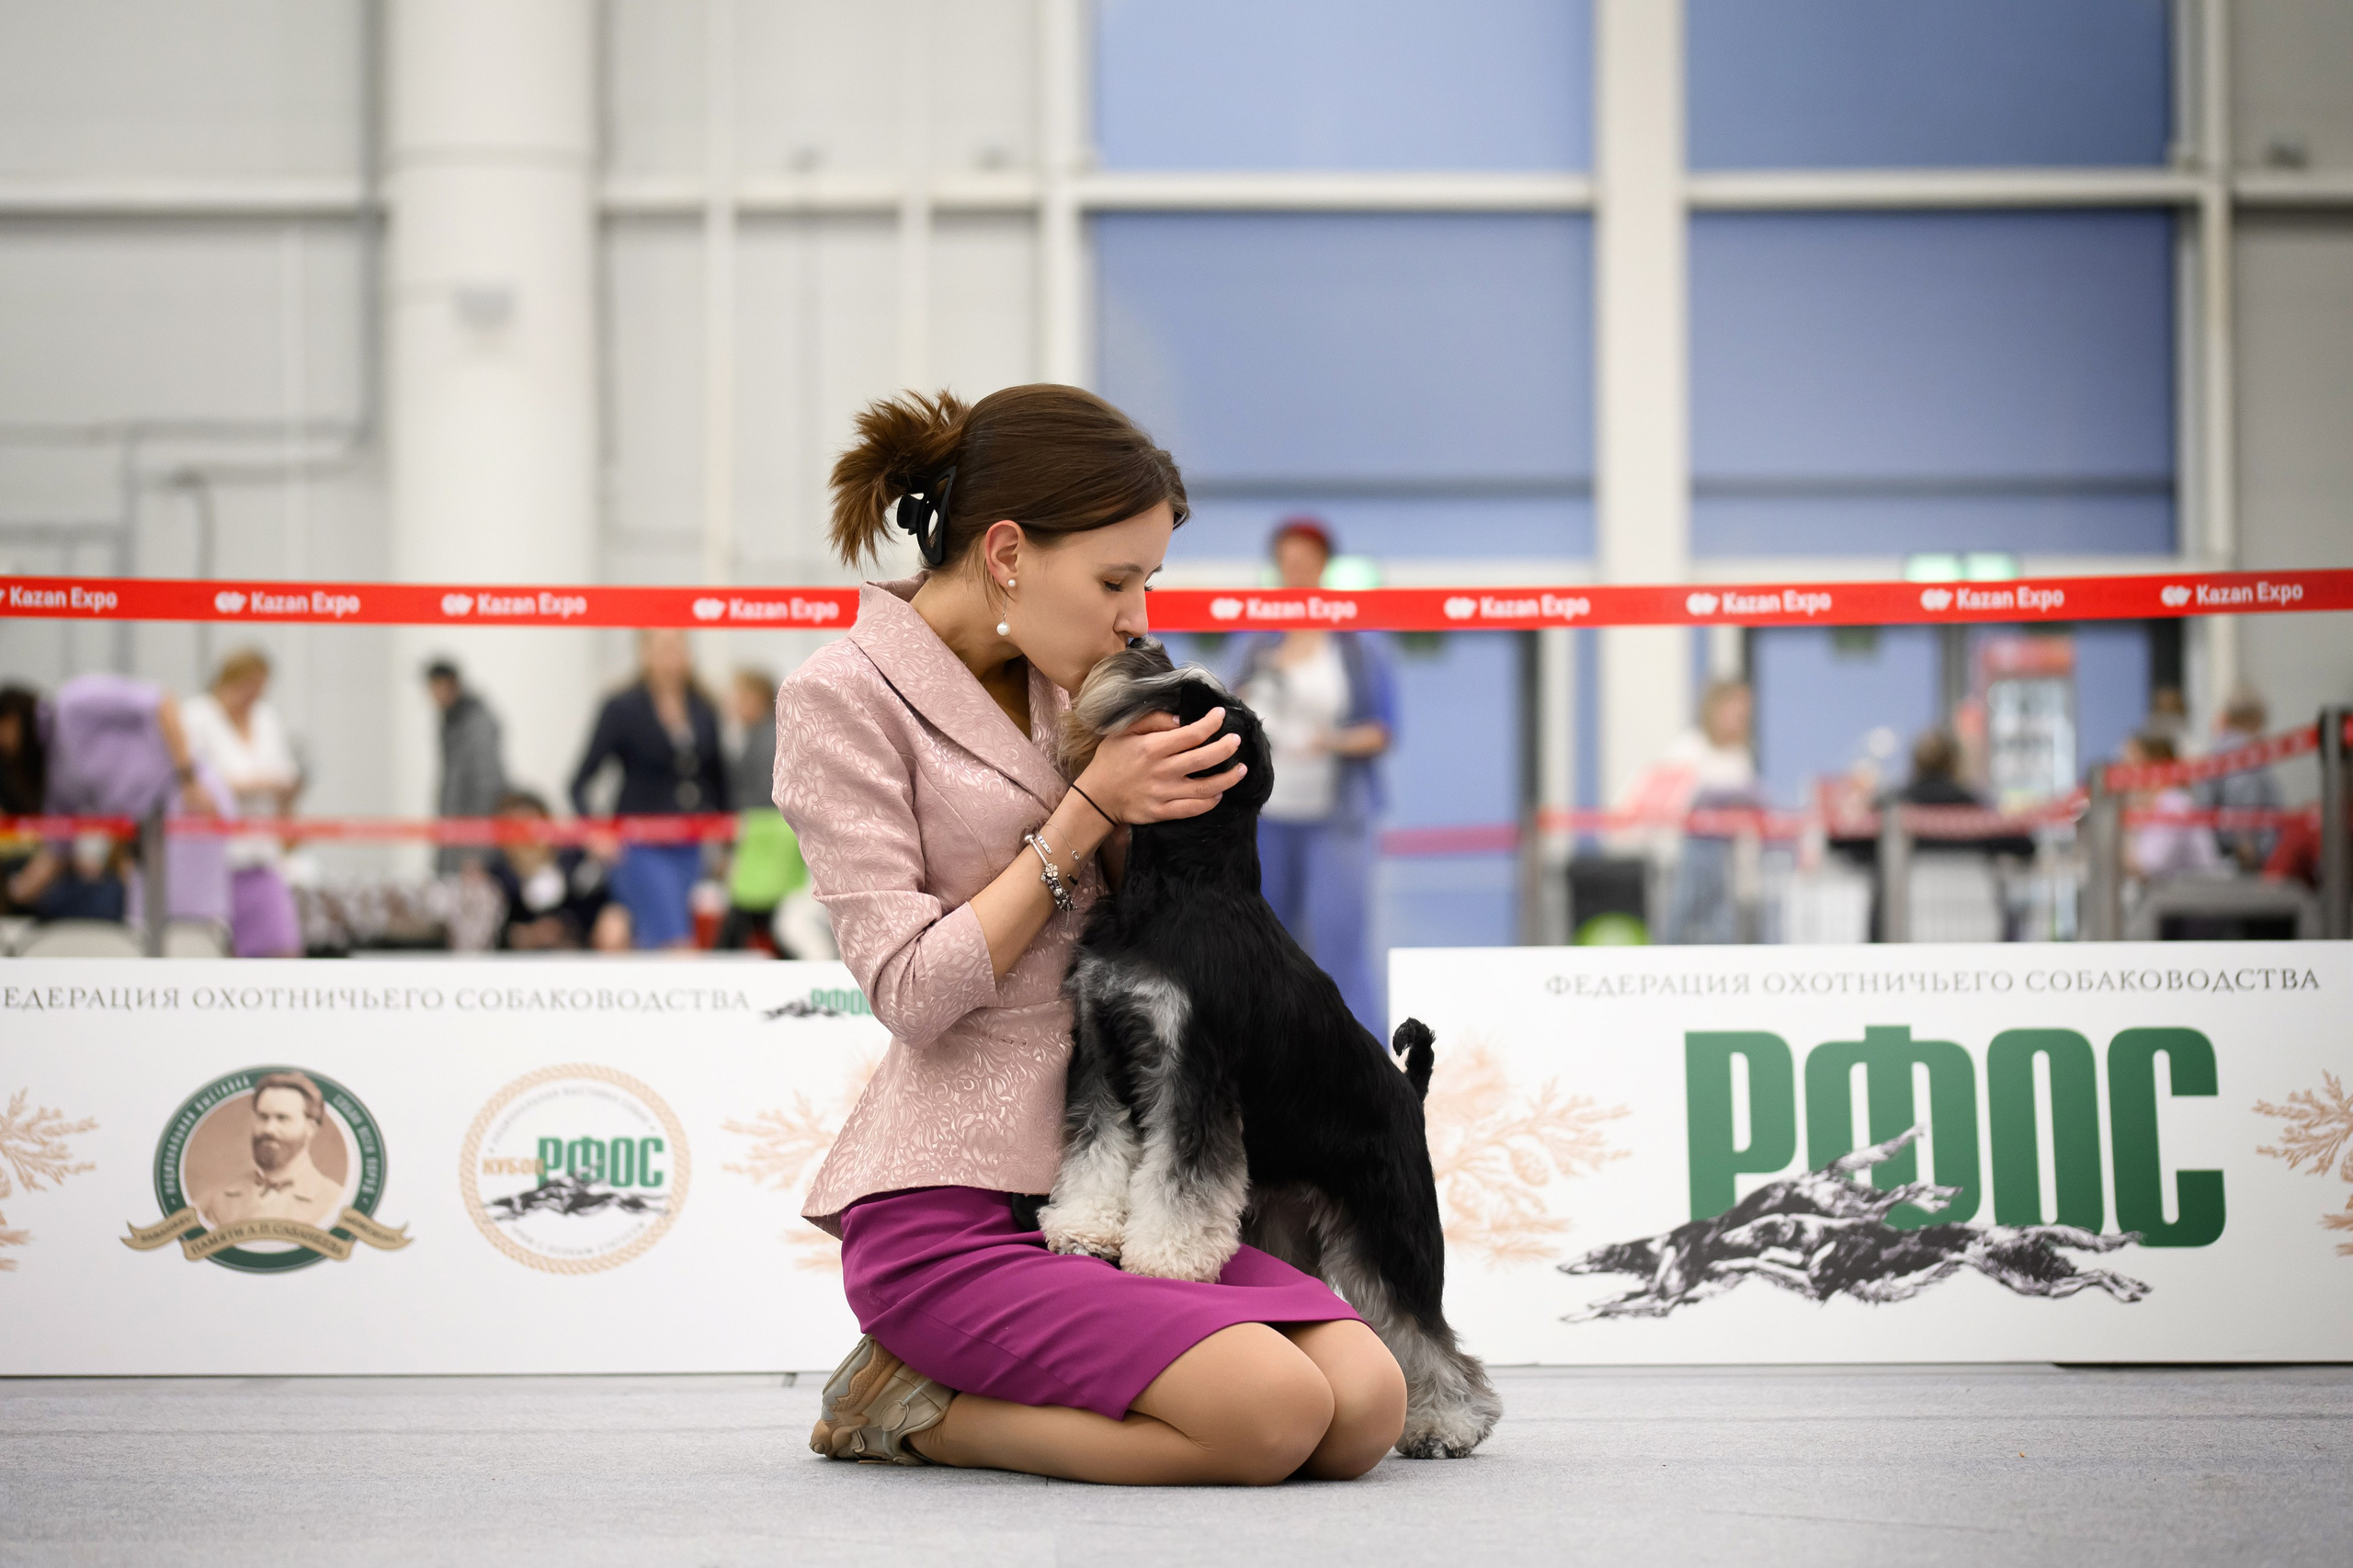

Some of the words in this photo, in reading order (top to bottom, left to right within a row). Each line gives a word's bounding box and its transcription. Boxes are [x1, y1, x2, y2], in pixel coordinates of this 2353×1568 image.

[9, 585, 67, 608] Kazan
[70, 586, 119, 612] Expo
[250, 591, 309, 614] Kazan
[311, 591, 361, 617] Expo
[477, 593, 536, 616] Kazan
[538, 593, 587, 619] Expo
[1480, 597, 1539, 618] Kazan
[1540, 594, 1591, 619] Expo
[1722, 593, 1780, 614] Kazan
[1782, 589, 1833, 616] Expo
[1956, 588, 2015, 608] Kazan
[2017, 585, 2065, 611] Expo
[2196, 584, 2253, 605] Kazan
[2256, 581, 2303, 606] Expo
[729, 597, 789, 619] Kazan
[790, 597, 840, 623] Expo
[1246, 598, 1306, 619] Kazan
[1307, 597, 1358, 622] Expo
[1544, 971, 1752, 998] ФЕДЕРАЦИЯ
[1762, 970, 2015, 994] ОХОТНИЧЬЕГО
[2025, 967, 2323, 994] СОБАКОВОДСТВА
[191, 986, 445, 1010] ОХОТНИЧЬЕГО
[454, 987, 751, 1012] СОБАКОВОДСТВА
[811, 988, 872, 1015] РФО
[1686, 1025, 2226, 1248] РФОС
[538, 1136, 665, 1188] РФОС
